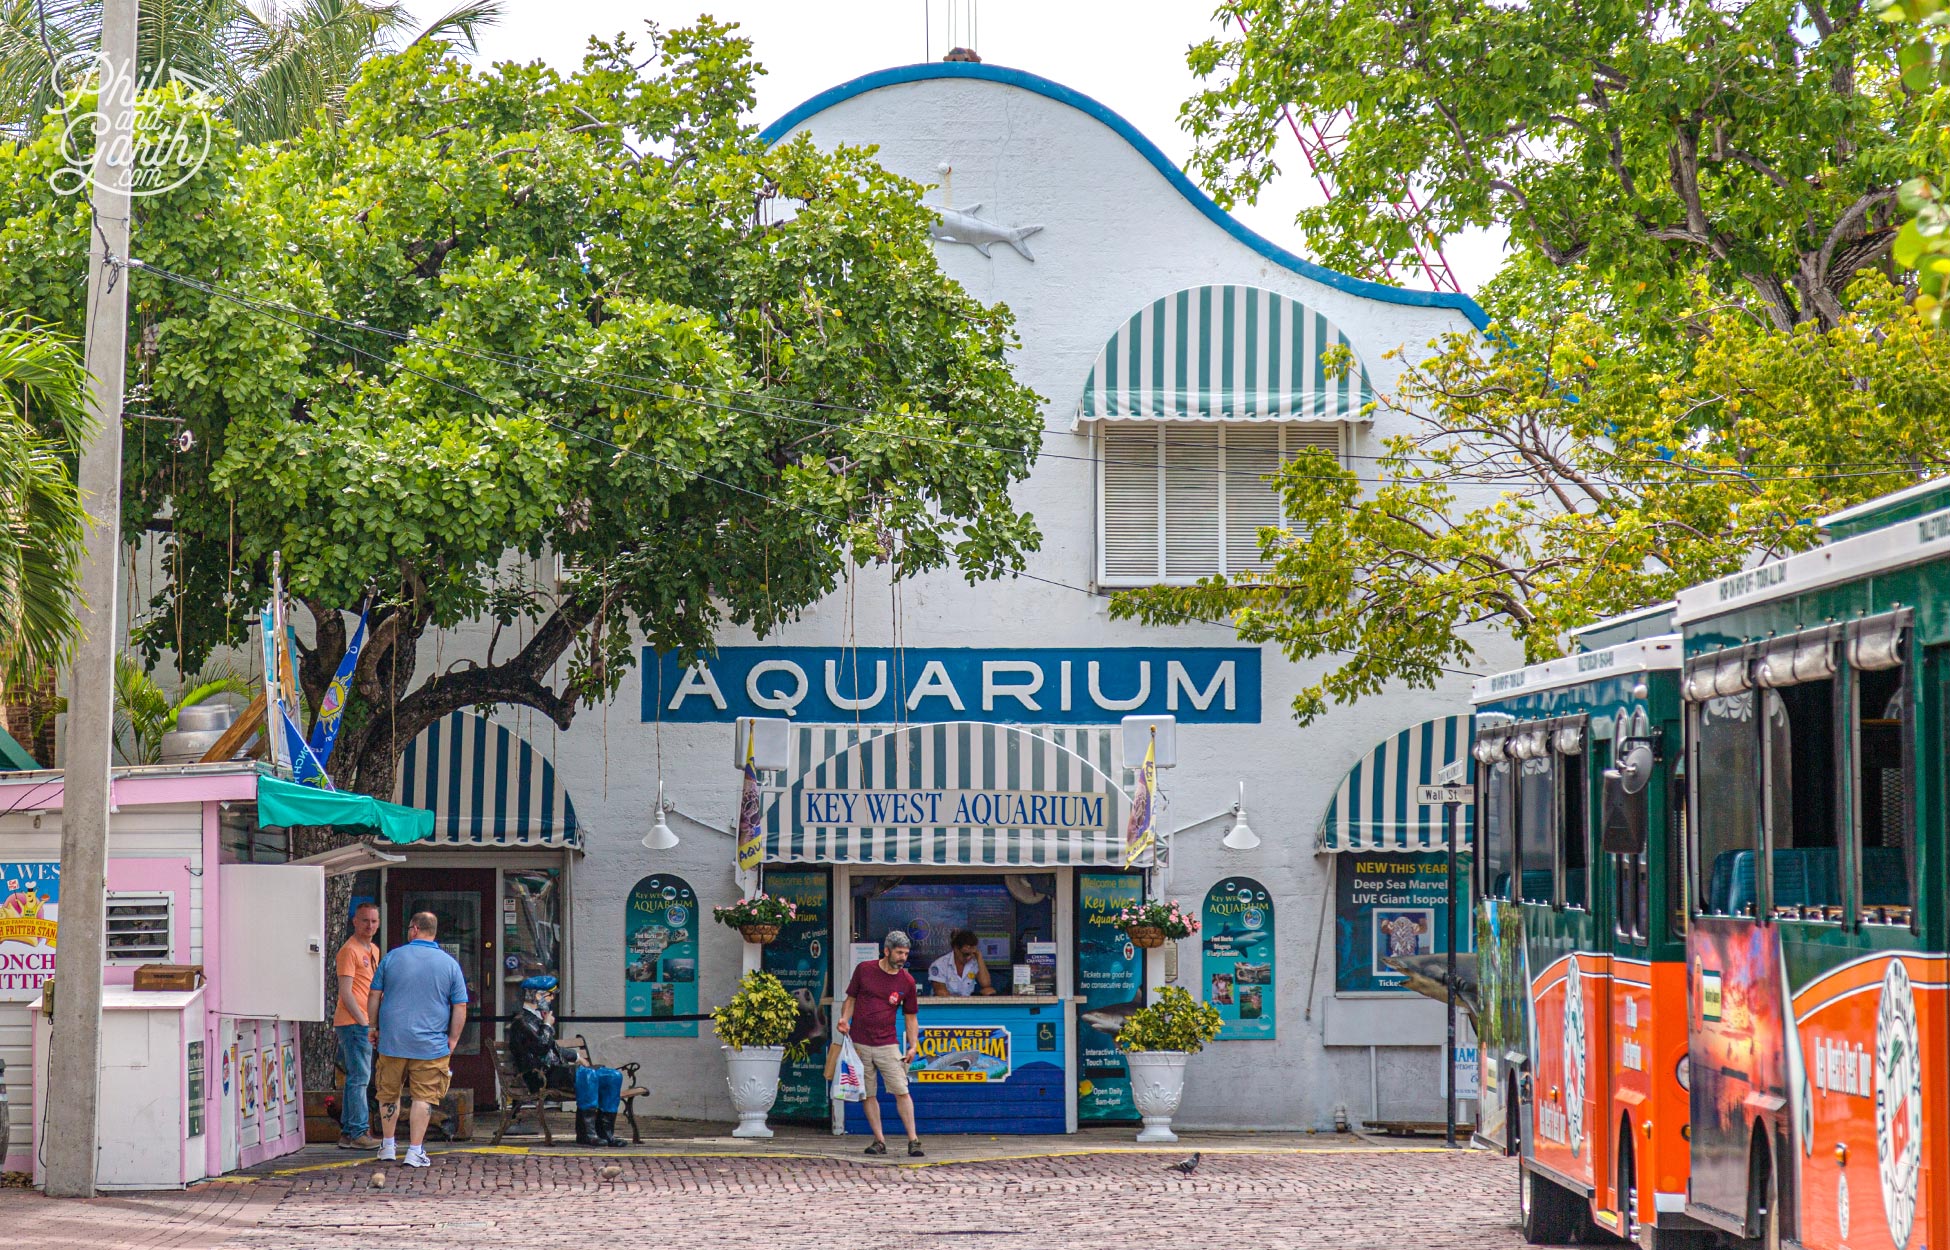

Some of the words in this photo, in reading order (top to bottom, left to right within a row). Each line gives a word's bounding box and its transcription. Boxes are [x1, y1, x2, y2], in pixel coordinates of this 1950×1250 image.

[667, 659, 1237, 716] AQUARIUM
[1425, 789, 1443, 800] Wall
[1448, 789, 1458, 800] St
[806, 792, 858, 826] KEY
[866, 792, 942, 824] WEST
[953, 792, 1105, 828] AQUARIUM
[16, 864, 60, 880] WES
[1356, 862, 1387, 873] NEW
[1390, 864, 1416, 873] THIS
[1418, 864, 1448, 873] YEAR
[1354, 880, 1383, 891] Deep
[1386, 880, 1406, 889] Sea
[796, 894, 822, 906] West
[1084, 895, 1105, 912] Key
[1352, 893, 1377, 904] LIVE
[1380, 893, 1410, 904] Giant
[633, 900, 694, 914] AQUARIUM
[1210, 903, 1269, 916] AQUARIUM
[5, 925, 36, 936] FRITTER
[37, 926, 58, 940] STAN
[0, 954, 55, 970] ONCH
[1112, 970, 1124, 980] good
[1085, 1048, 1114, 1056] Interactive
[922, 1073, 984, 1081] TICKETS
[1093, 1088, 1108, 1096] Open
